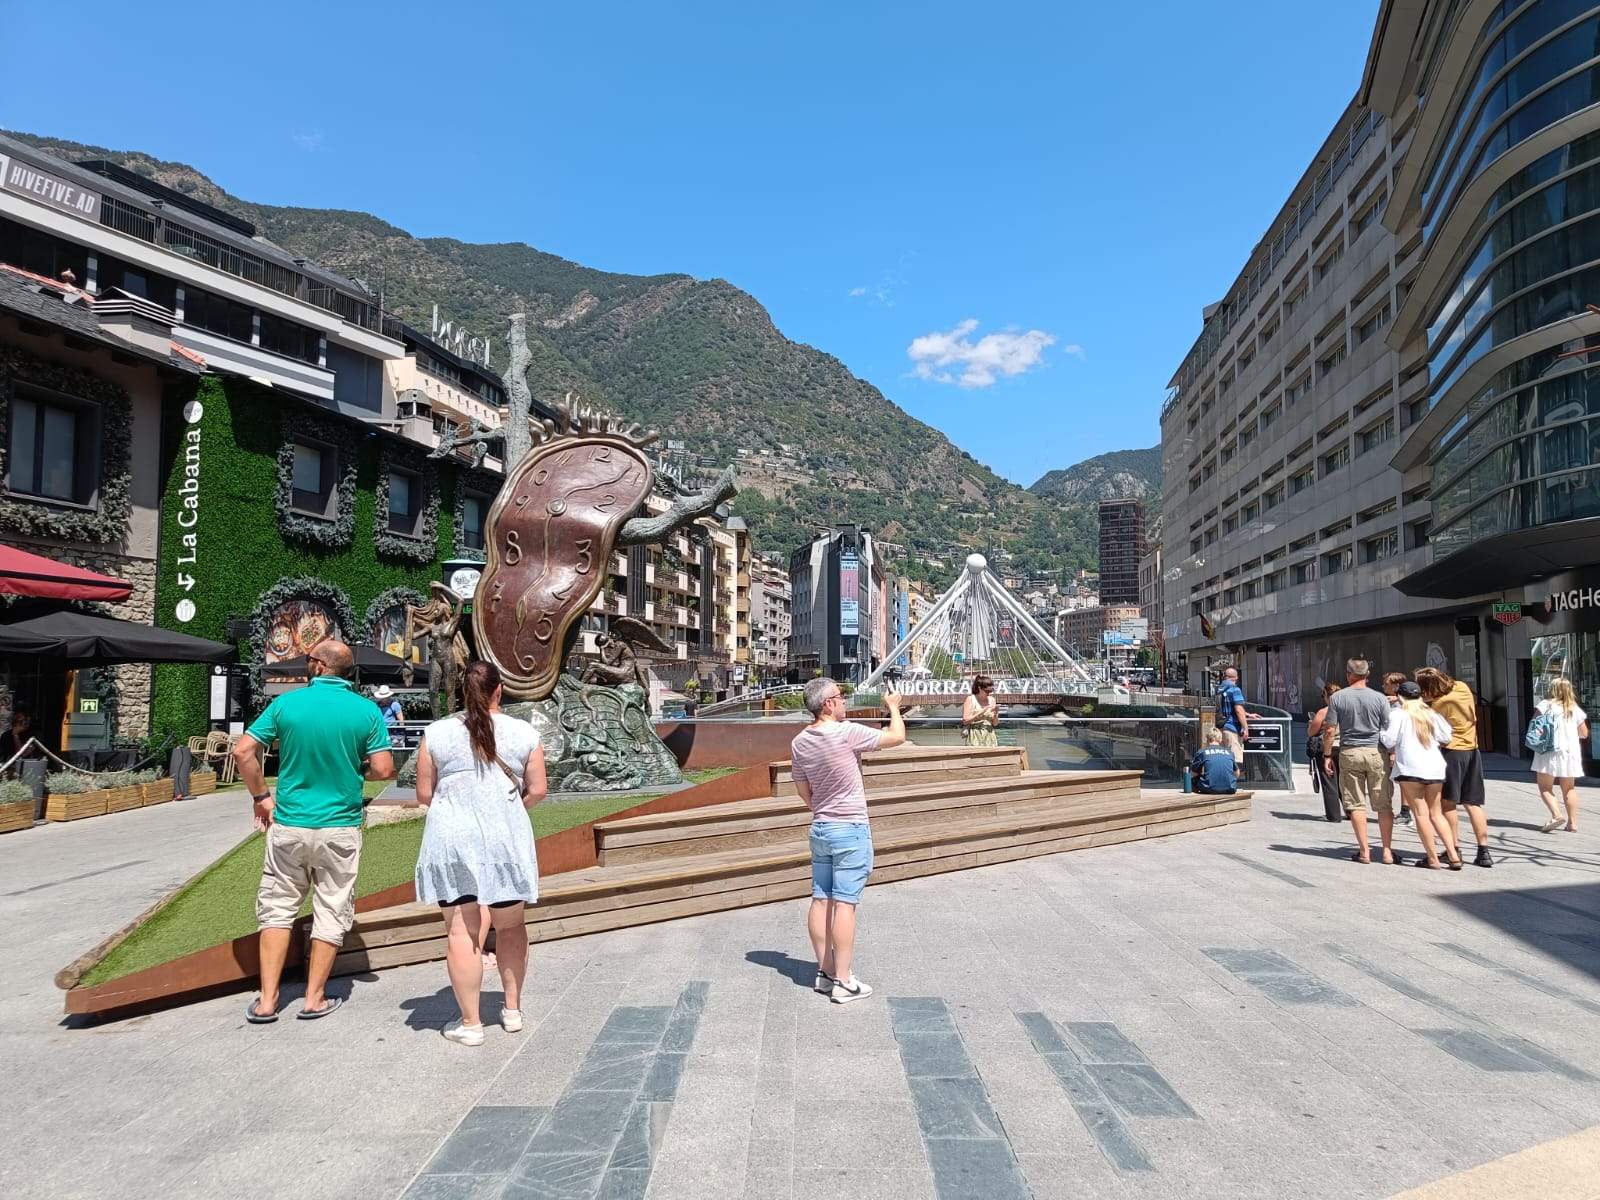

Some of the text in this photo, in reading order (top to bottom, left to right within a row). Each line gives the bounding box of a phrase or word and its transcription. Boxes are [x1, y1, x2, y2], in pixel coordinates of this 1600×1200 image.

[10, 166, 95, 213] HIVEFIVE.AD
[588, 447, 612, 463] 12
[177, 428, 201, 527] Cabana
[528, 469, 550, 486] 10
[515, 495, 531, 515] 9
[593, 494, 617, 514] 2
[177, 532, 197, 565] La
[505, 530, 523, 566] 8
[574, 539, 593, 575] 3
[1497, 604, 1519, 612] TAG
[533, 609, 558, 641] 5
